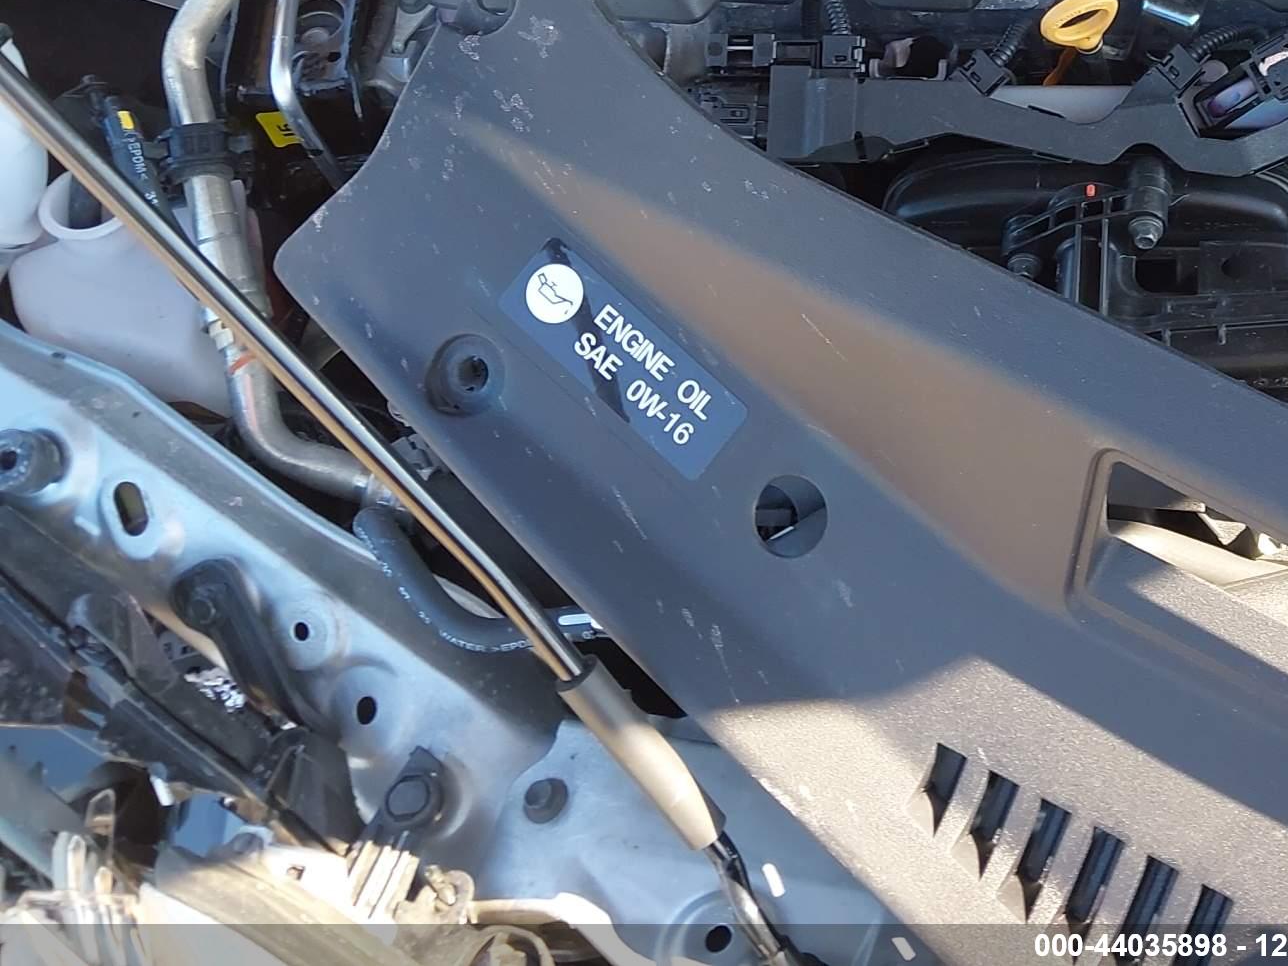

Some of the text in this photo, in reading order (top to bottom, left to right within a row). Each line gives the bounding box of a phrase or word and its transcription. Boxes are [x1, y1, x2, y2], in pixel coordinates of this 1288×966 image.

[574, 332, 695, 445] SAE 0W-16
[593, 304, 712, 421] ENGINE OIL
